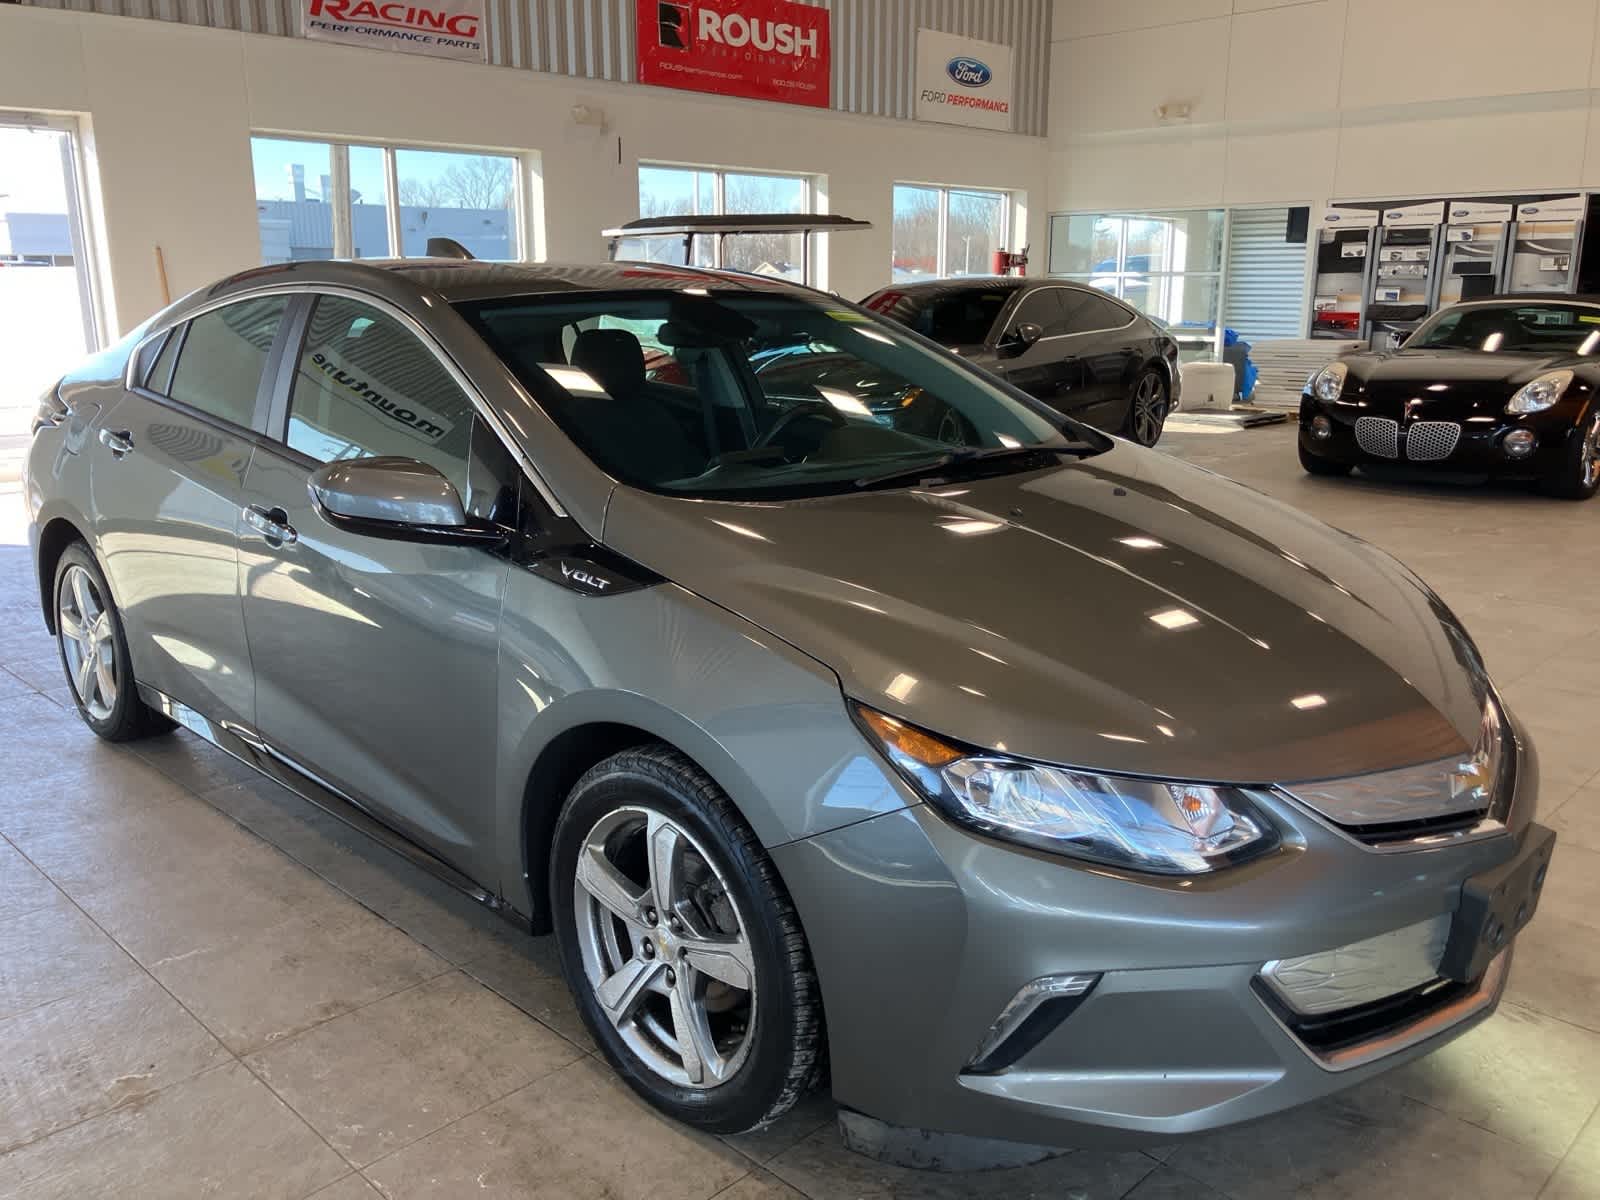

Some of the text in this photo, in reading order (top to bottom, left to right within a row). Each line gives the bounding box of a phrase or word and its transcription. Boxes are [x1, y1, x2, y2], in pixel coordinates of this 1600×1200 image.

[310, 0, 478, 38] RACING
[698, 8, 817, 59] ROUSH
[310, 20, 481, 50] PERFORMANCE PARTS
[921, 90, 1009, 113] FORD PERFORMANCE
[561, 560, 611, 589] VOLT
